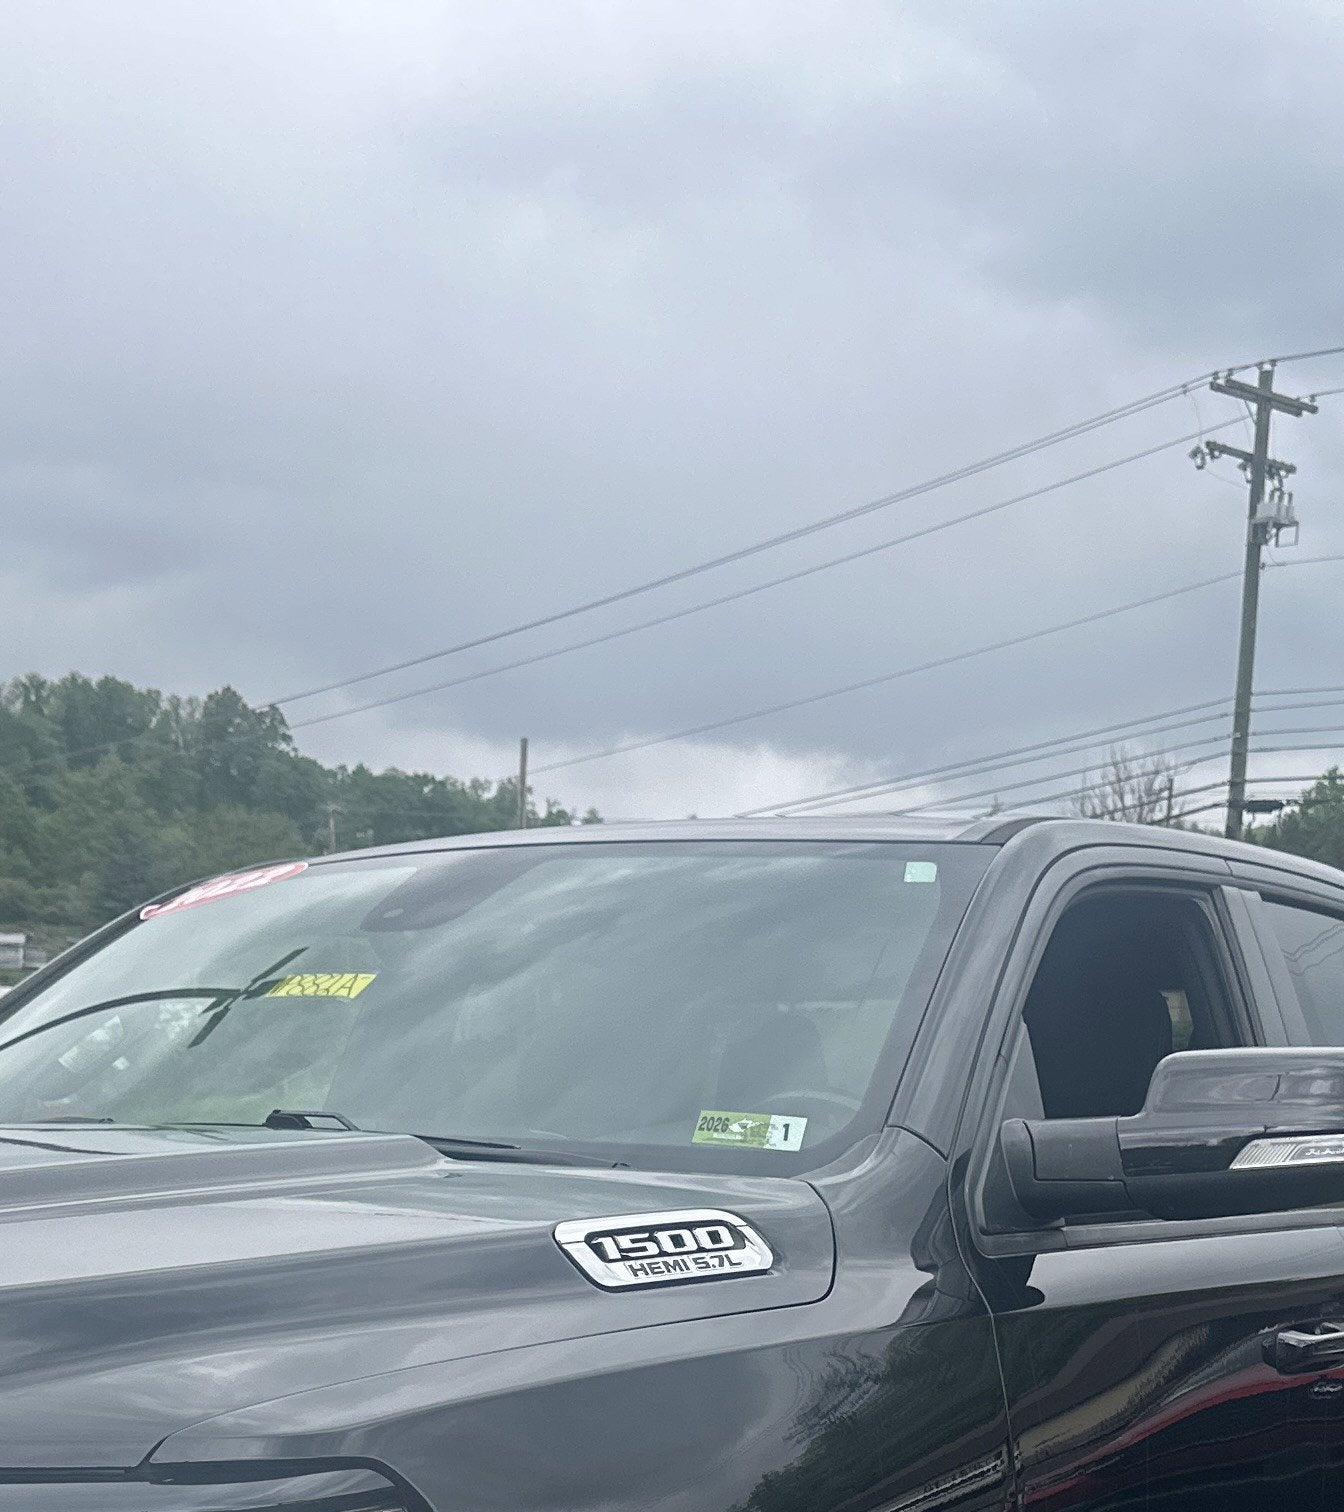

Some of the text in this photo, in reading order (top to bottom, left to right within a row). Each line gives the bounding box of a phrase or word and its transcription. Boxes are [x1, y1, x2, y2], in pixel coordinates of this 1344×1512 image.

[698, 1116, 729, 1133] 2026
[782, 1123, 790, 1141] 1
[593, 1226, 734, 1260] 1500
[629, 1254, 742, 1278] HEMI 5.7L
